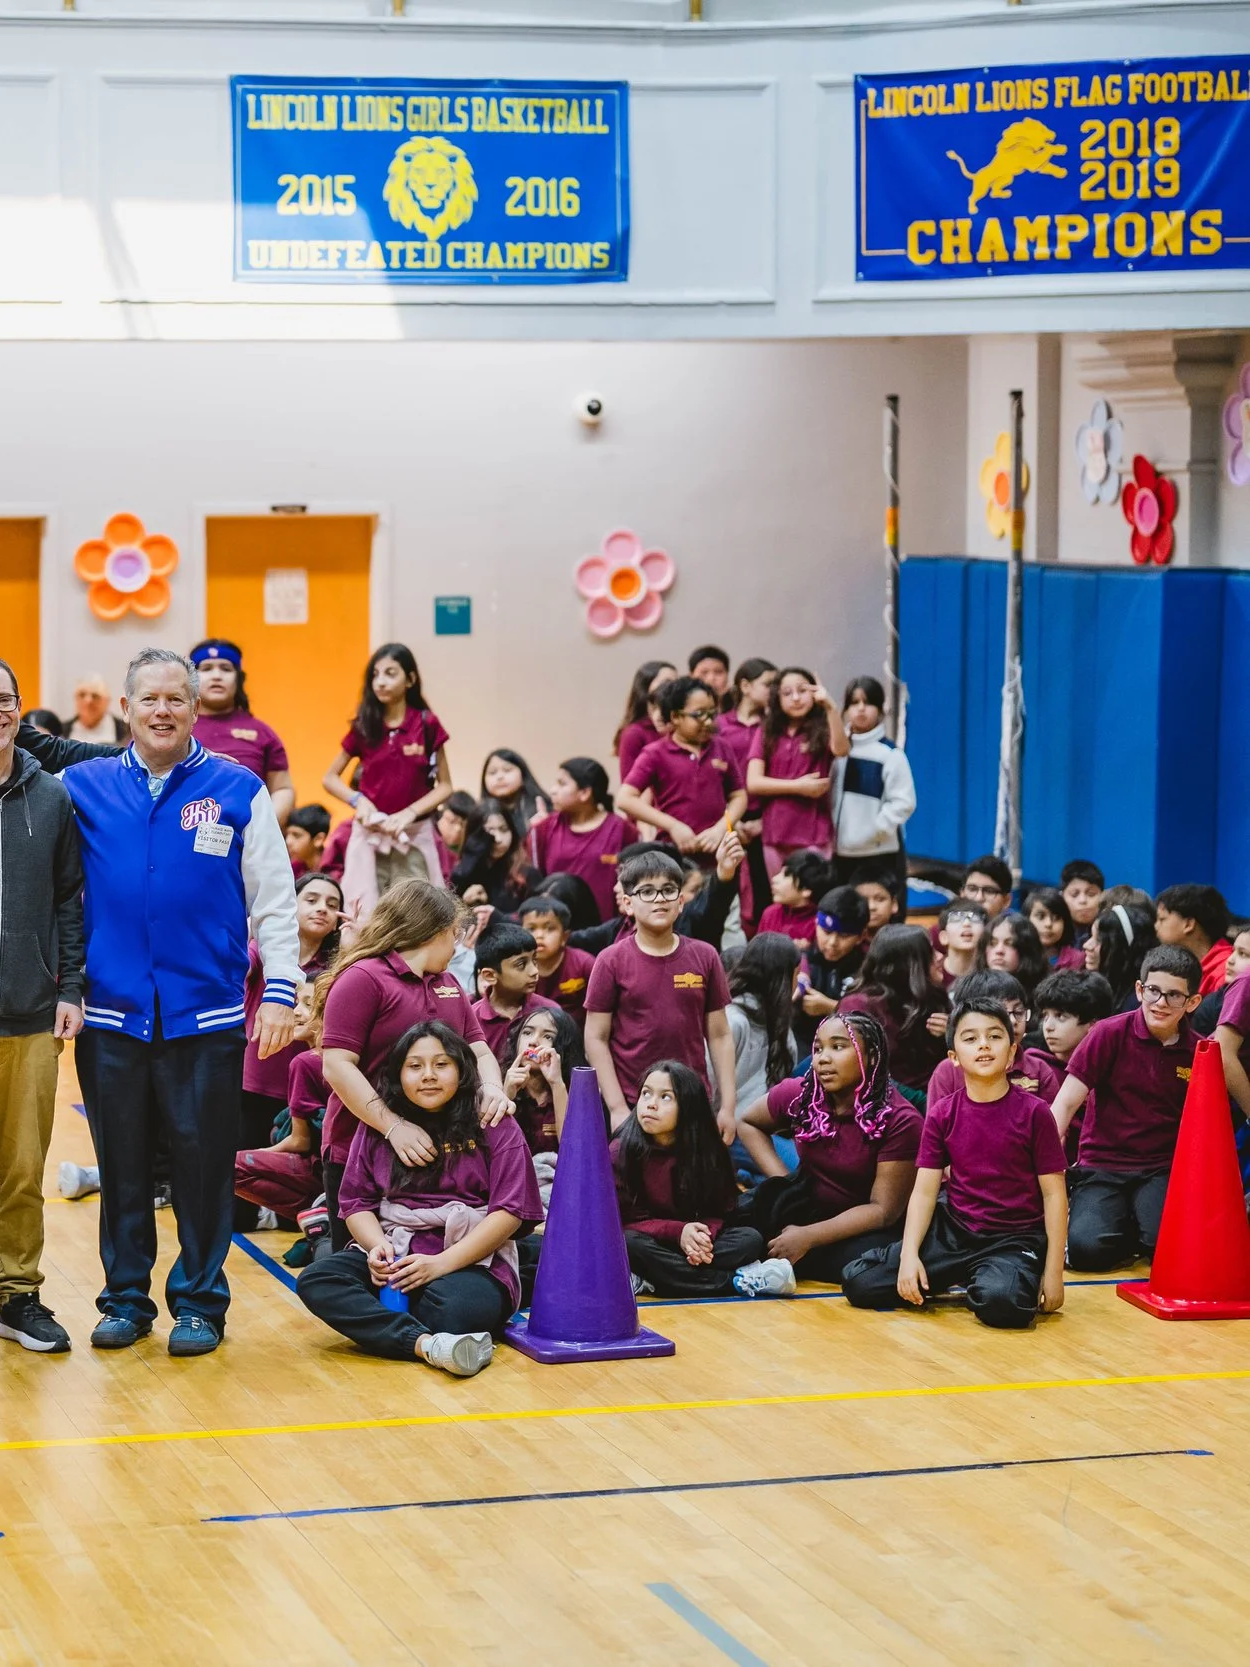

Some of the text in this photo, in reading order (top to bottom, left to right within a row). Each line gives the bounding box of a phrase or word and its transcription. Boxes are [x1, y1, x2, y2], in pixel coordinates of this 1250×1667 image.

[246, 94, 610, 134] LINCOLN LIONS GIRLS BASKETBALL
[867, 69, 1250, 118] LINCOLN LIONS FLAG FOOTBAL
[1080, 116, 1180, 159] 2018
[276, 174, 580, 217] 2015 2016
[1080, 158, 1180, 201] 2019
[247, 240, 610, 270] UNDEFEATED CHAMPIONS
[907, 209, 1222, 266] CHAMPIONS
[197, 835, 218, 843] VISITOR
